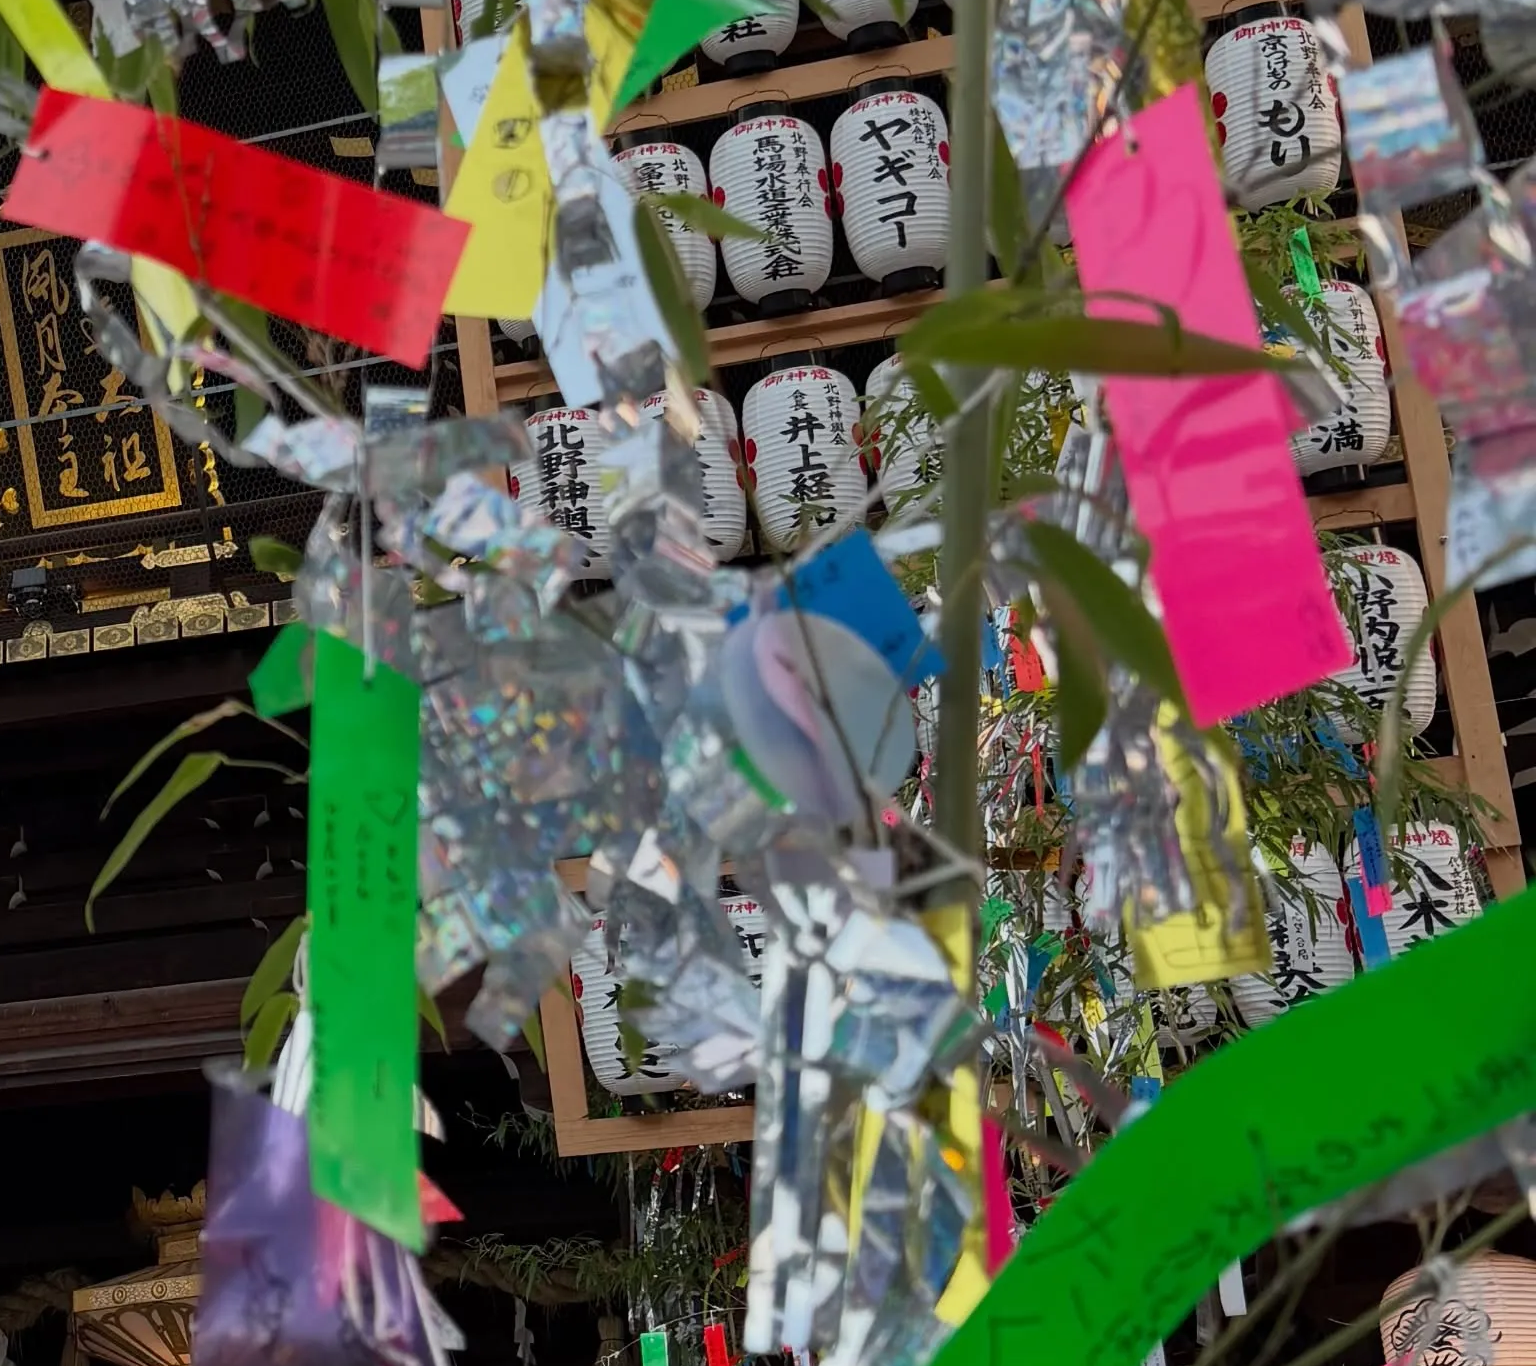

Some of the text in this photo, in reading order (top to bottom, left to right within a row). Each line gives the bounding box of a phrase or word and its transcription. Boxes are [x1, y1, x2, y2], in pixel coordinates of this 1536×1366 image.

[1233, 19, 1305, 41] 御神燈
[849, 92, 919, 114] 御神燈
[1257, 34, 1311, 167] 京つけもの もり
[1299, 32, 1326, 111] 北野奉行会
[732, 118, 800, 136] 御神燈
[921, 108, 943, 180] 北野奉行会
[791, 132, 814, 208] 北野奉行会
[859, 118, 918, 249] ヤギコー
[763, 369, 833, 388] 御神燈
